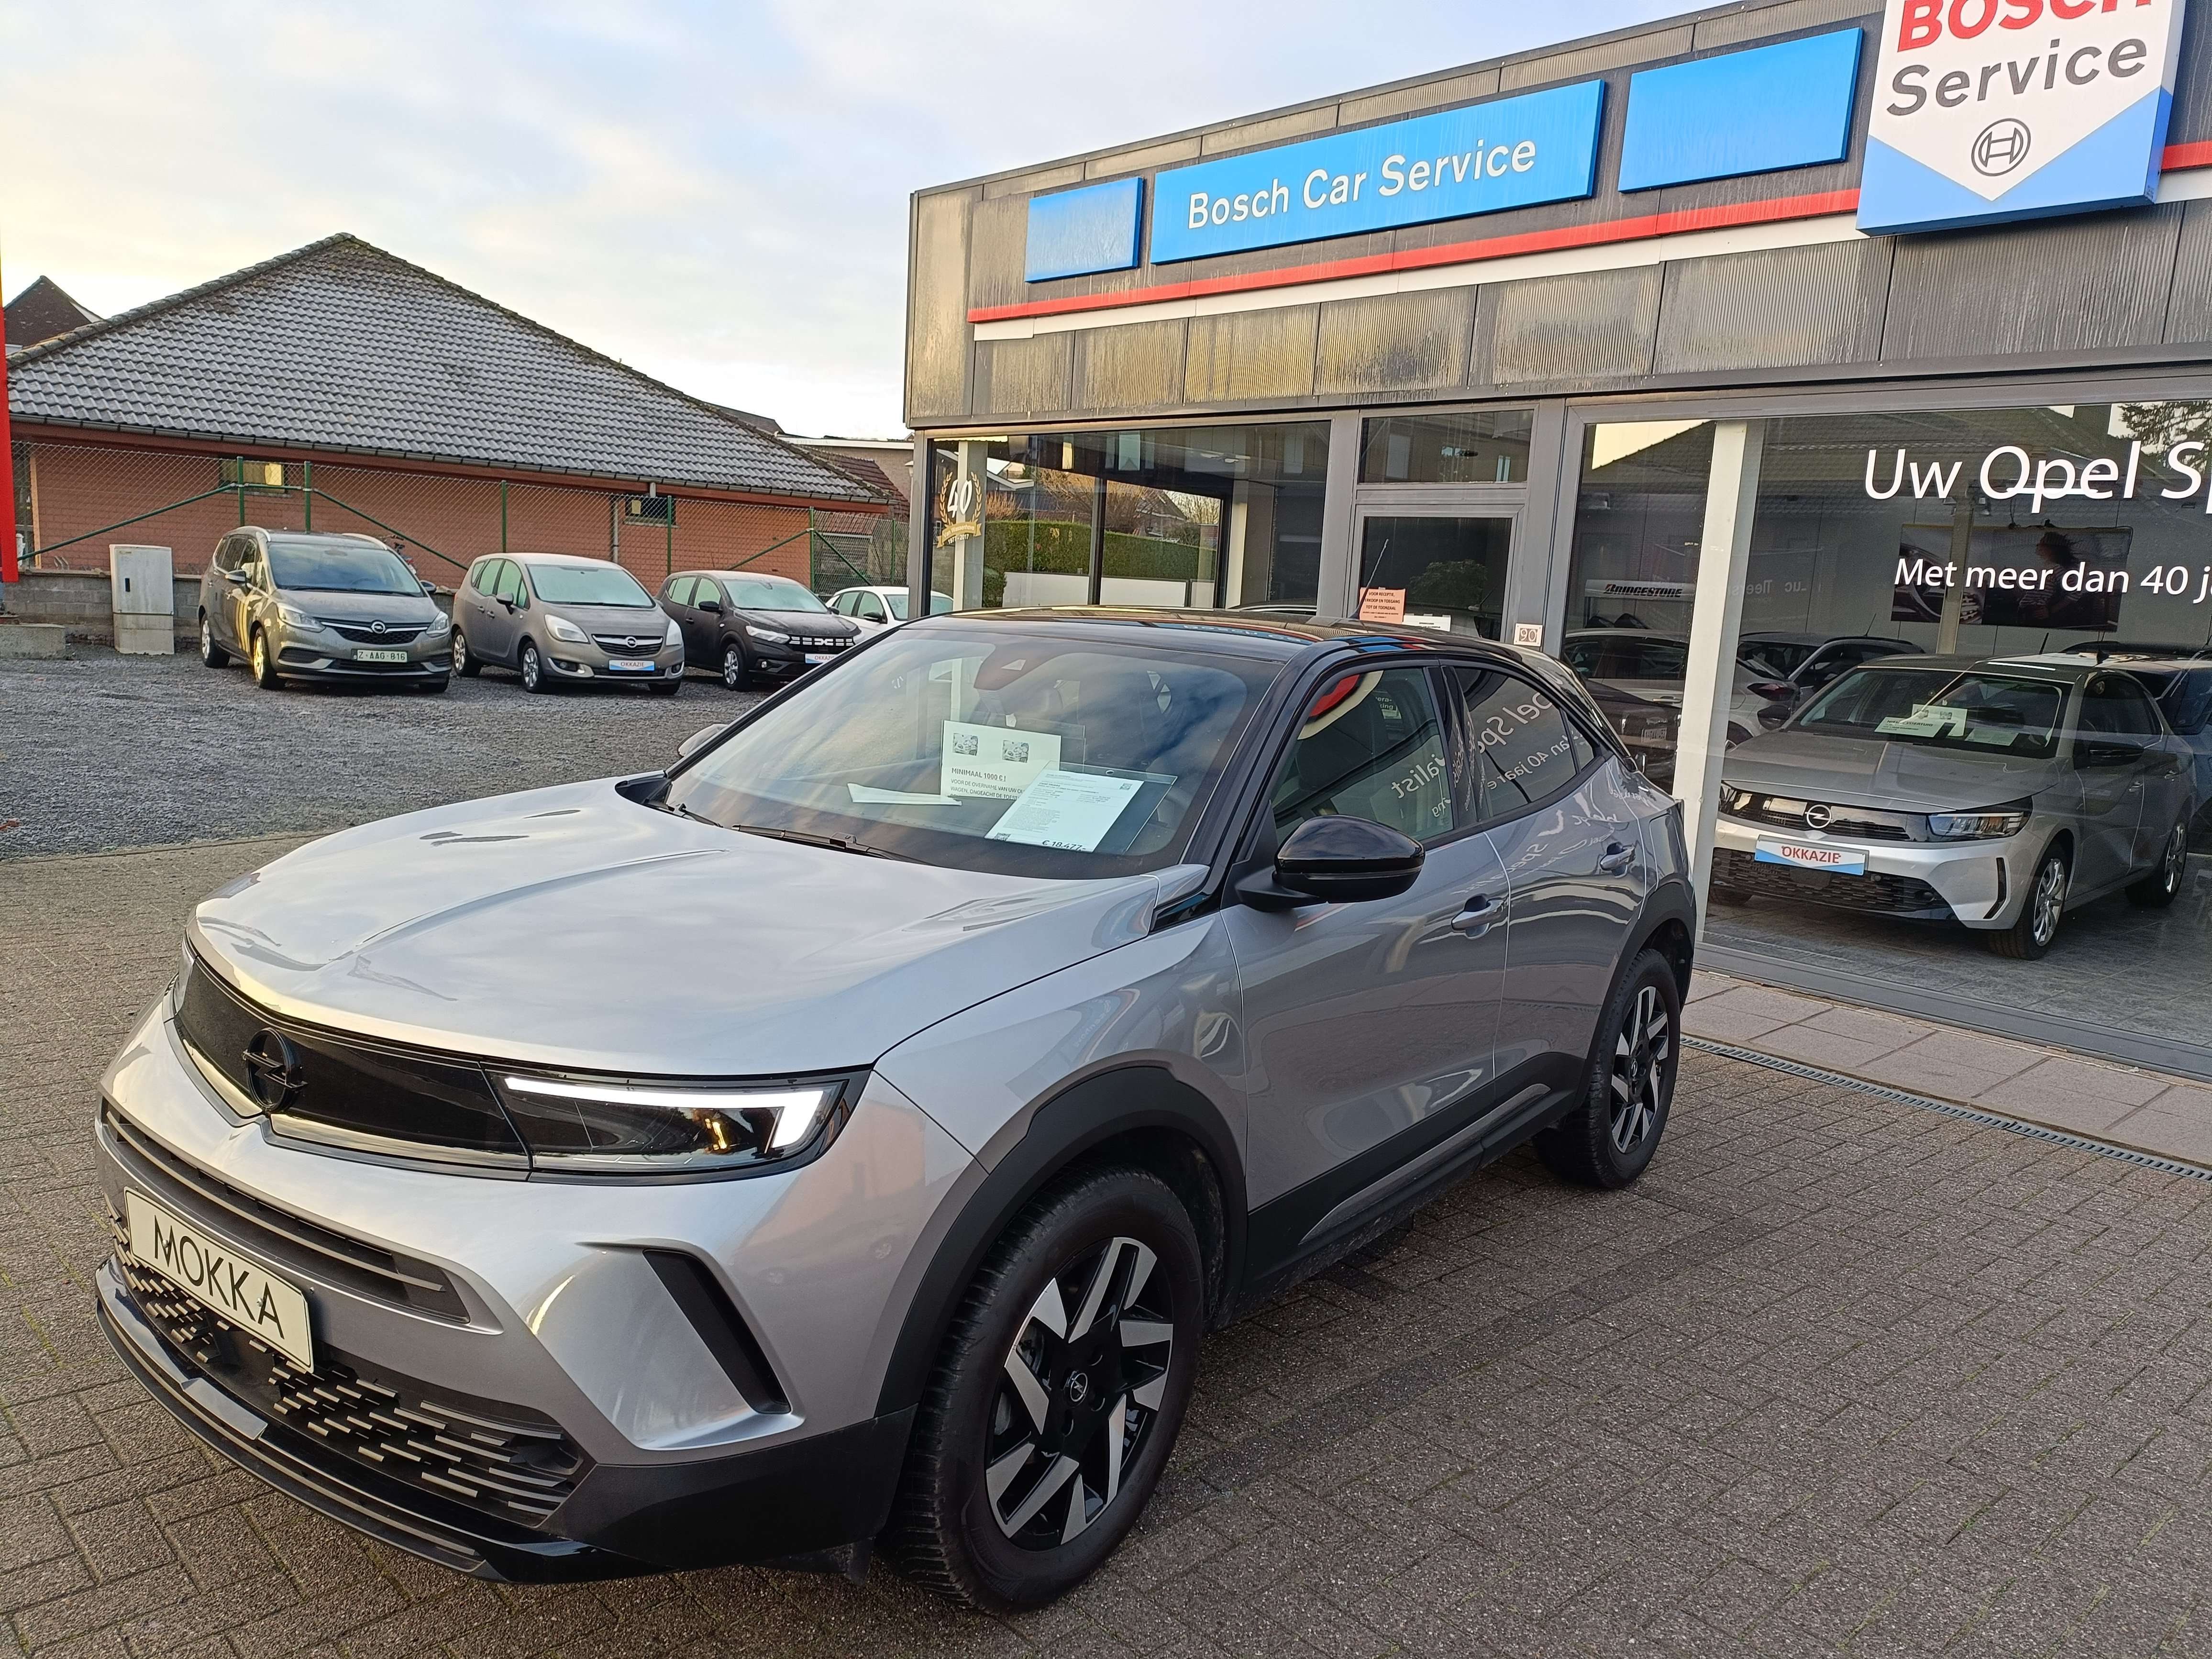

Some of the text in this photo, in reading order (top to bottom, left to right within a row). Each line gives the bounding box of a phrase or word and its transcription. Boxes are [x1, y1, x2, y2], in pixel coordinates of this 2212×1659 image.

[1886, 38, 2147, 116] Service
[1187, 139, 1536, 230] Bosch Car Service
[1865, 441, 2212, 514] Uw Opel S
[947, 479, 973, 518] 40
[1604, 584, 1682, 597] BRIDGESTONE
[1894, 558, 2212, 604] Met meer dan 40 j
[1520, 628, 1537, 641] 90
[951, 767, 983, 778] MINIMAAL
[972, 782, 997, 790] OVERNAME
[970, 789, 995, 797] ONGEACHT
[1781, 846, 1840, 863] OKKAZIE
[154, 1214, 285, 1340] MOKKA
